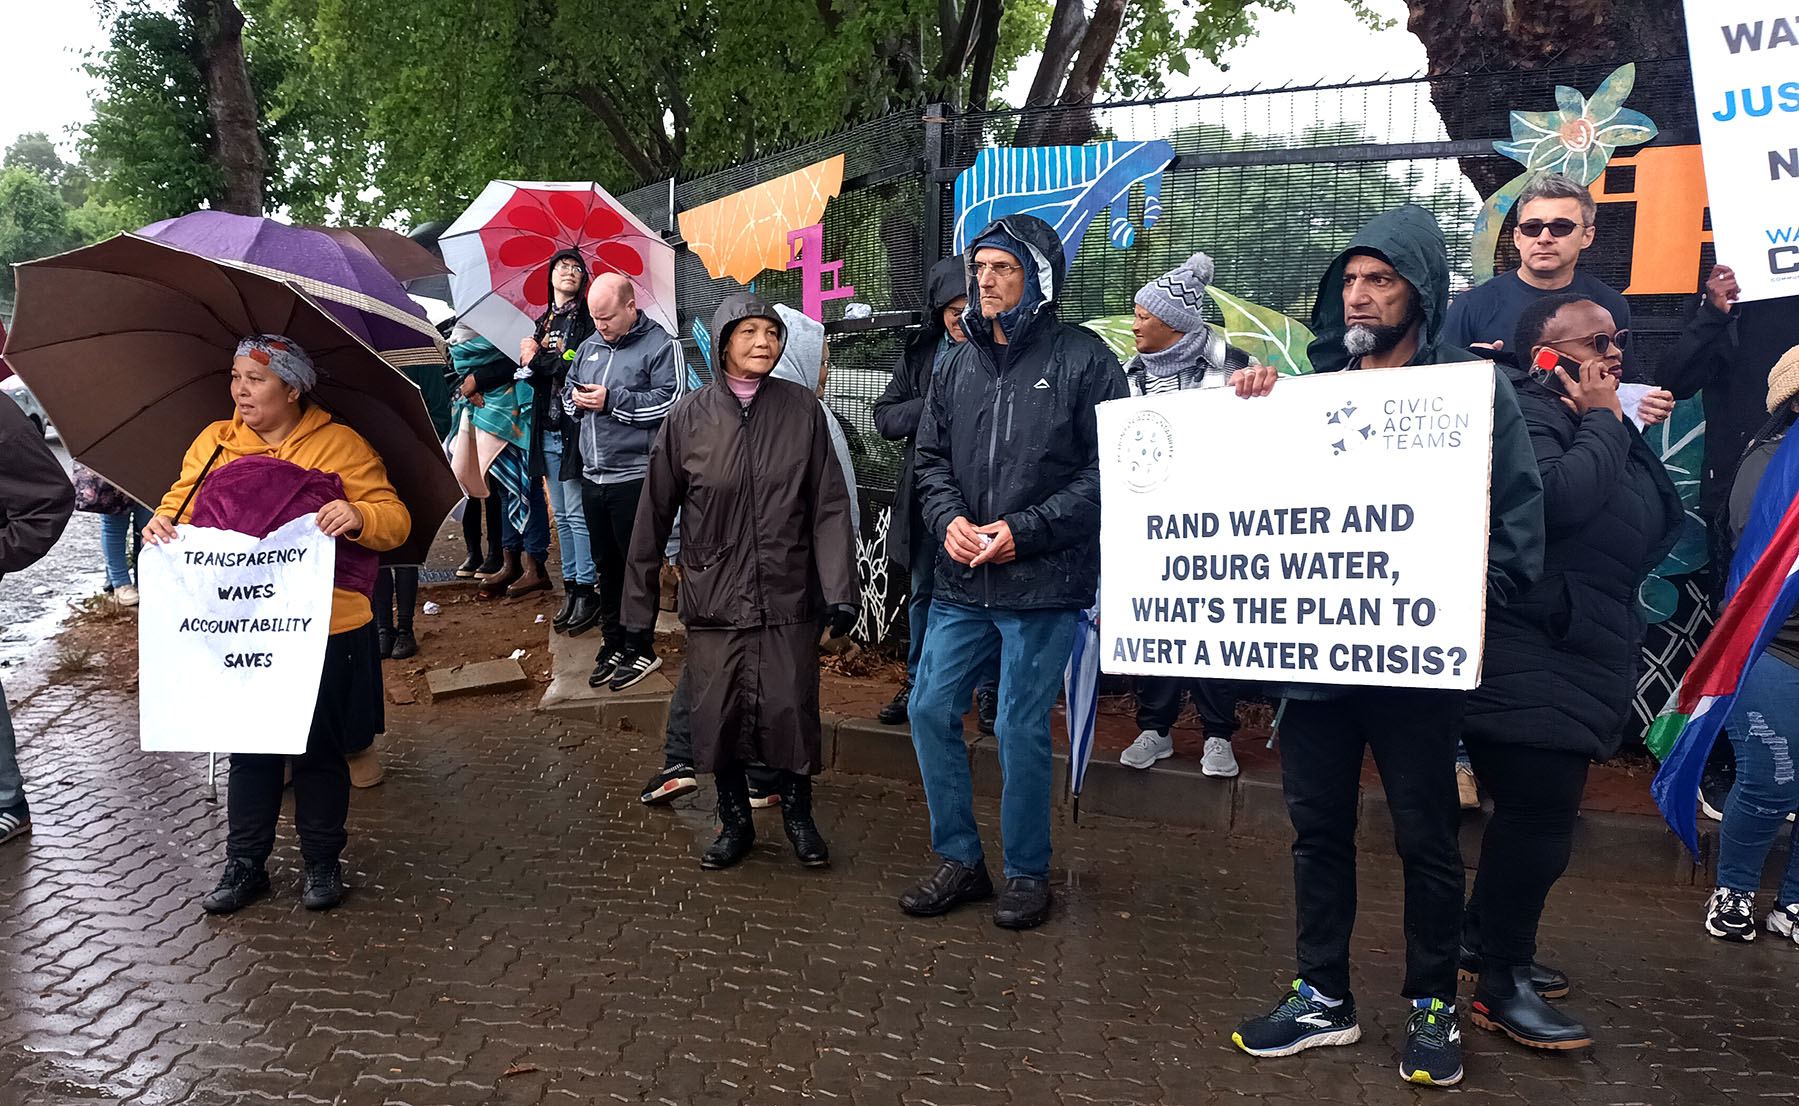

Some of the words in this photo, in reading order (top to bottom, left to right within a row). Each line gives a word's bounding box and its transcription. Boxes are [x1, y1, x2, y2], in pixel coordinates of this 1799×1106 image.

[1720, 15, 1799, 54] WA
[1712, 81, 1799, 122] JUS
[1383, 396, 1444, 415] CIVIC
[1383, 413, 1469, 433] ACTION
[1382, 430, 1462, 450] TEAMS
[1147, 512, 1220, 540] RAND
[1228, 506, 1331, 537] WATER
[1341, 503, 1415, 534] AND
[184, 547, 308, 568] TRANSPARENCY
[1161, 553, 1270, 582] JOBURG
[1279, 550, 1400, 586] WATER,
[217, 583, 276, 602] WAVES
[1131, 597, 1226, 624] WHAT’S
[1232, 597, 1288, 625] THE
[1296, 597, 1382, 626] PLAN
[1392, 597, 1436, 627] TO
[179, 617, 312, 634] ACCOUNTABILITY
[223, 652, 273, 669] SAVES
[1112, 637, 1187, 665] AVERT
[1193, 639, 1211, 666] A
[1219, 640, 1319, 671] WATER
[1328, 643, 1468, 677] CRISIS?
